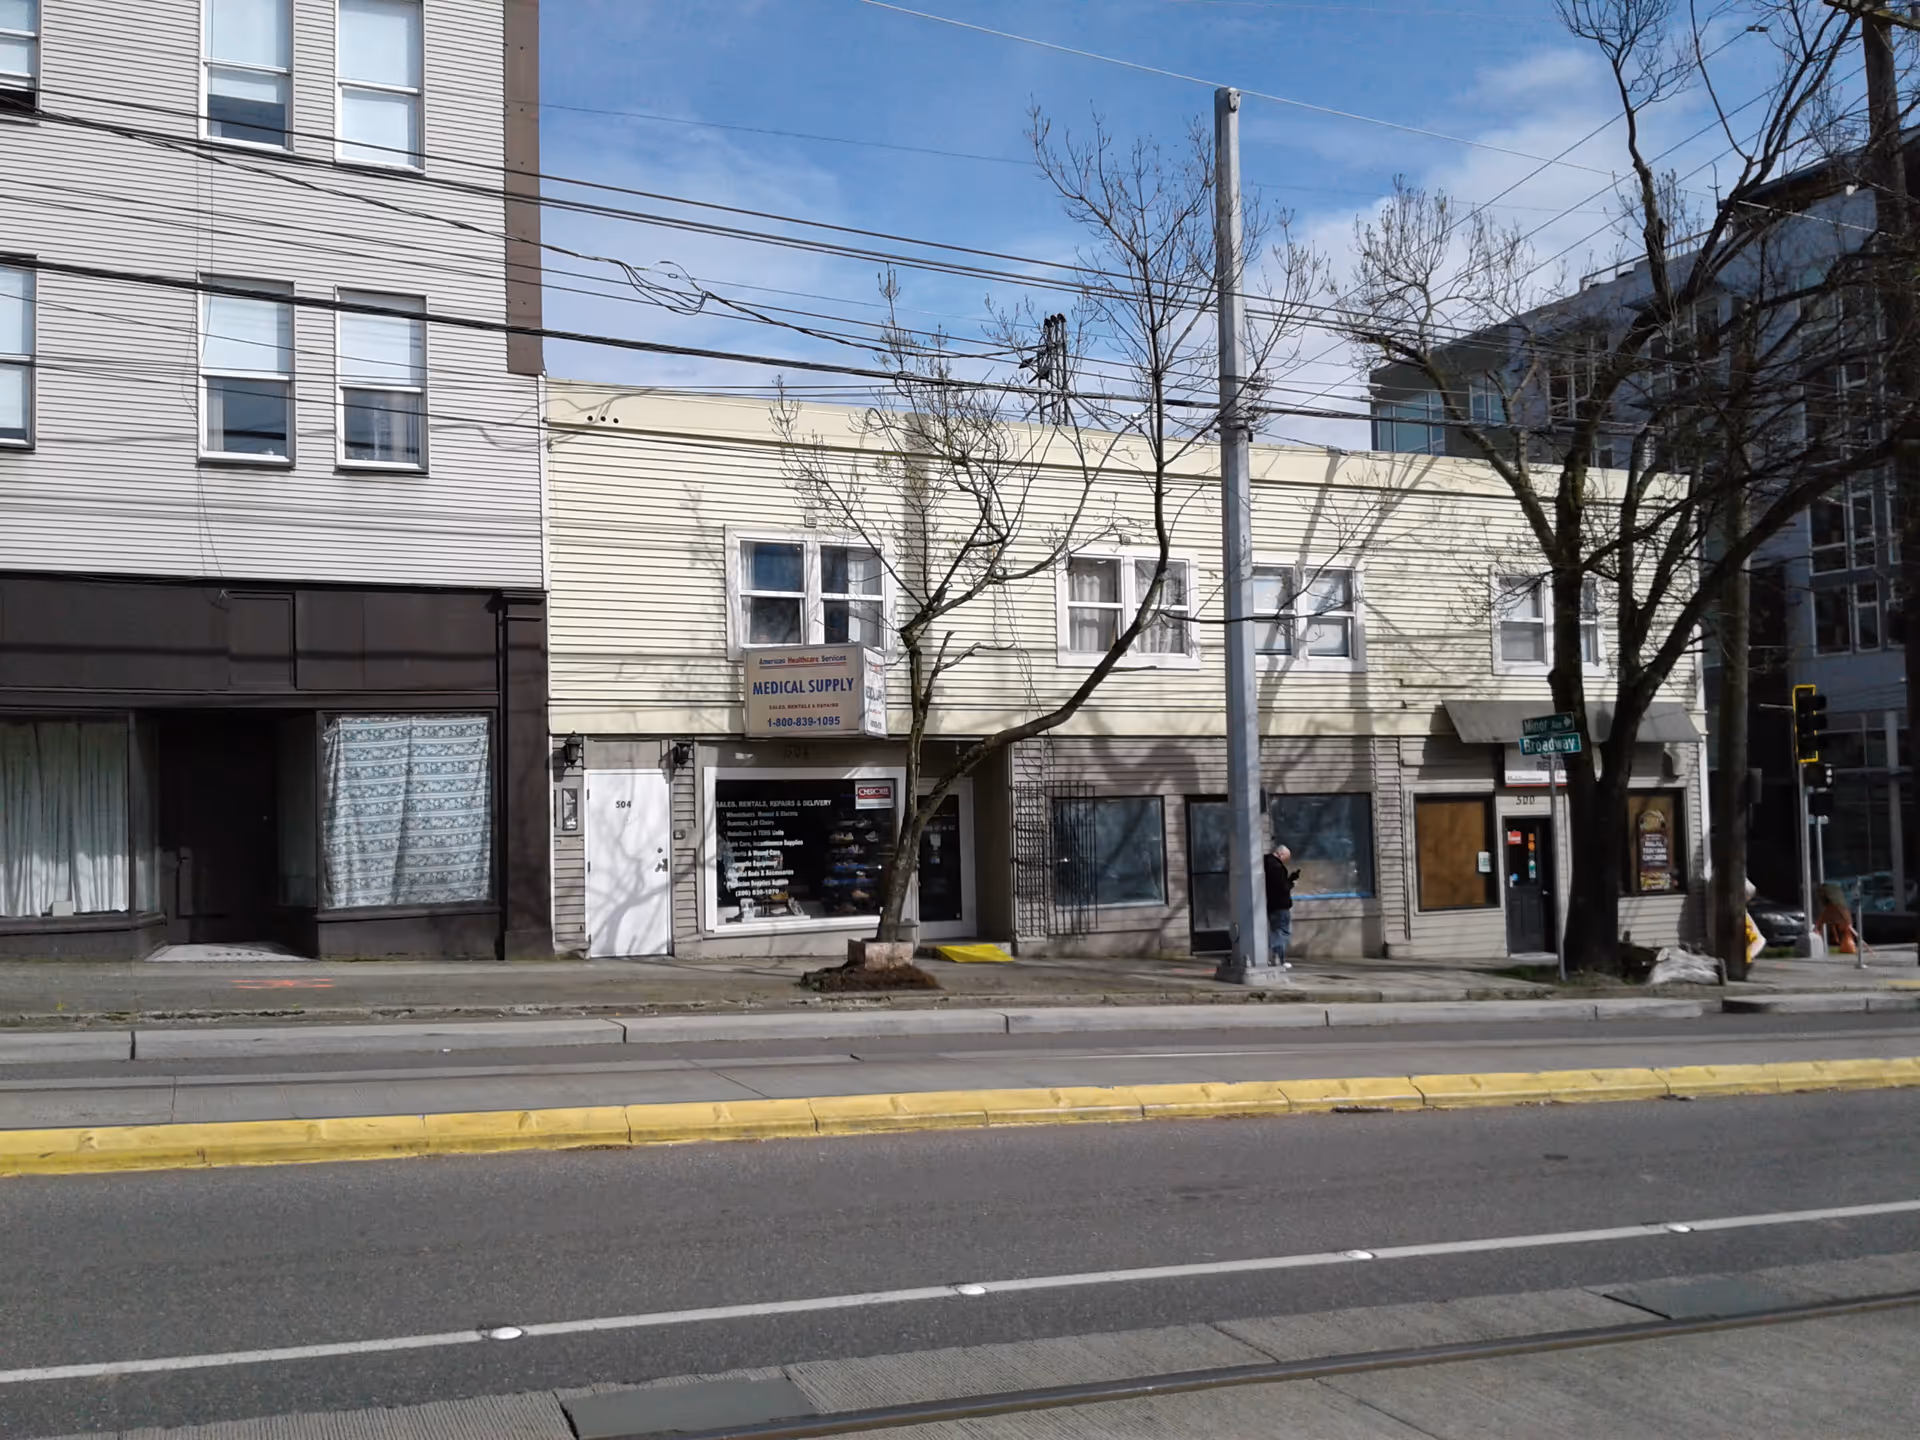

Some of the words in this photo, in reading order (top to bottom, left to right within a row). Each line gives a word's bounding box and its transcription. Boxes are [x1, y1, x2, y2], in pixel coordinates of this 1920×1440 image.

[787, 656, 819, 664] Healthcare
[821, 654, 847, 663] Services
[752, 680, 806, 695] MEDICAL
[808, 677, 854, 693] SUPPLY
[767, 716, 841, 728] 1-800-839-1095
[1524, 719, 1548, 731] Minor
[1523, 737, 1575, 752] Broadway
[615, 800, 632, 808] 504
[739, 800, 768, 808] RENTALS,
[802, 799, 832, 807] DELIVERY
[1515, 795, 1536, 805] 500
